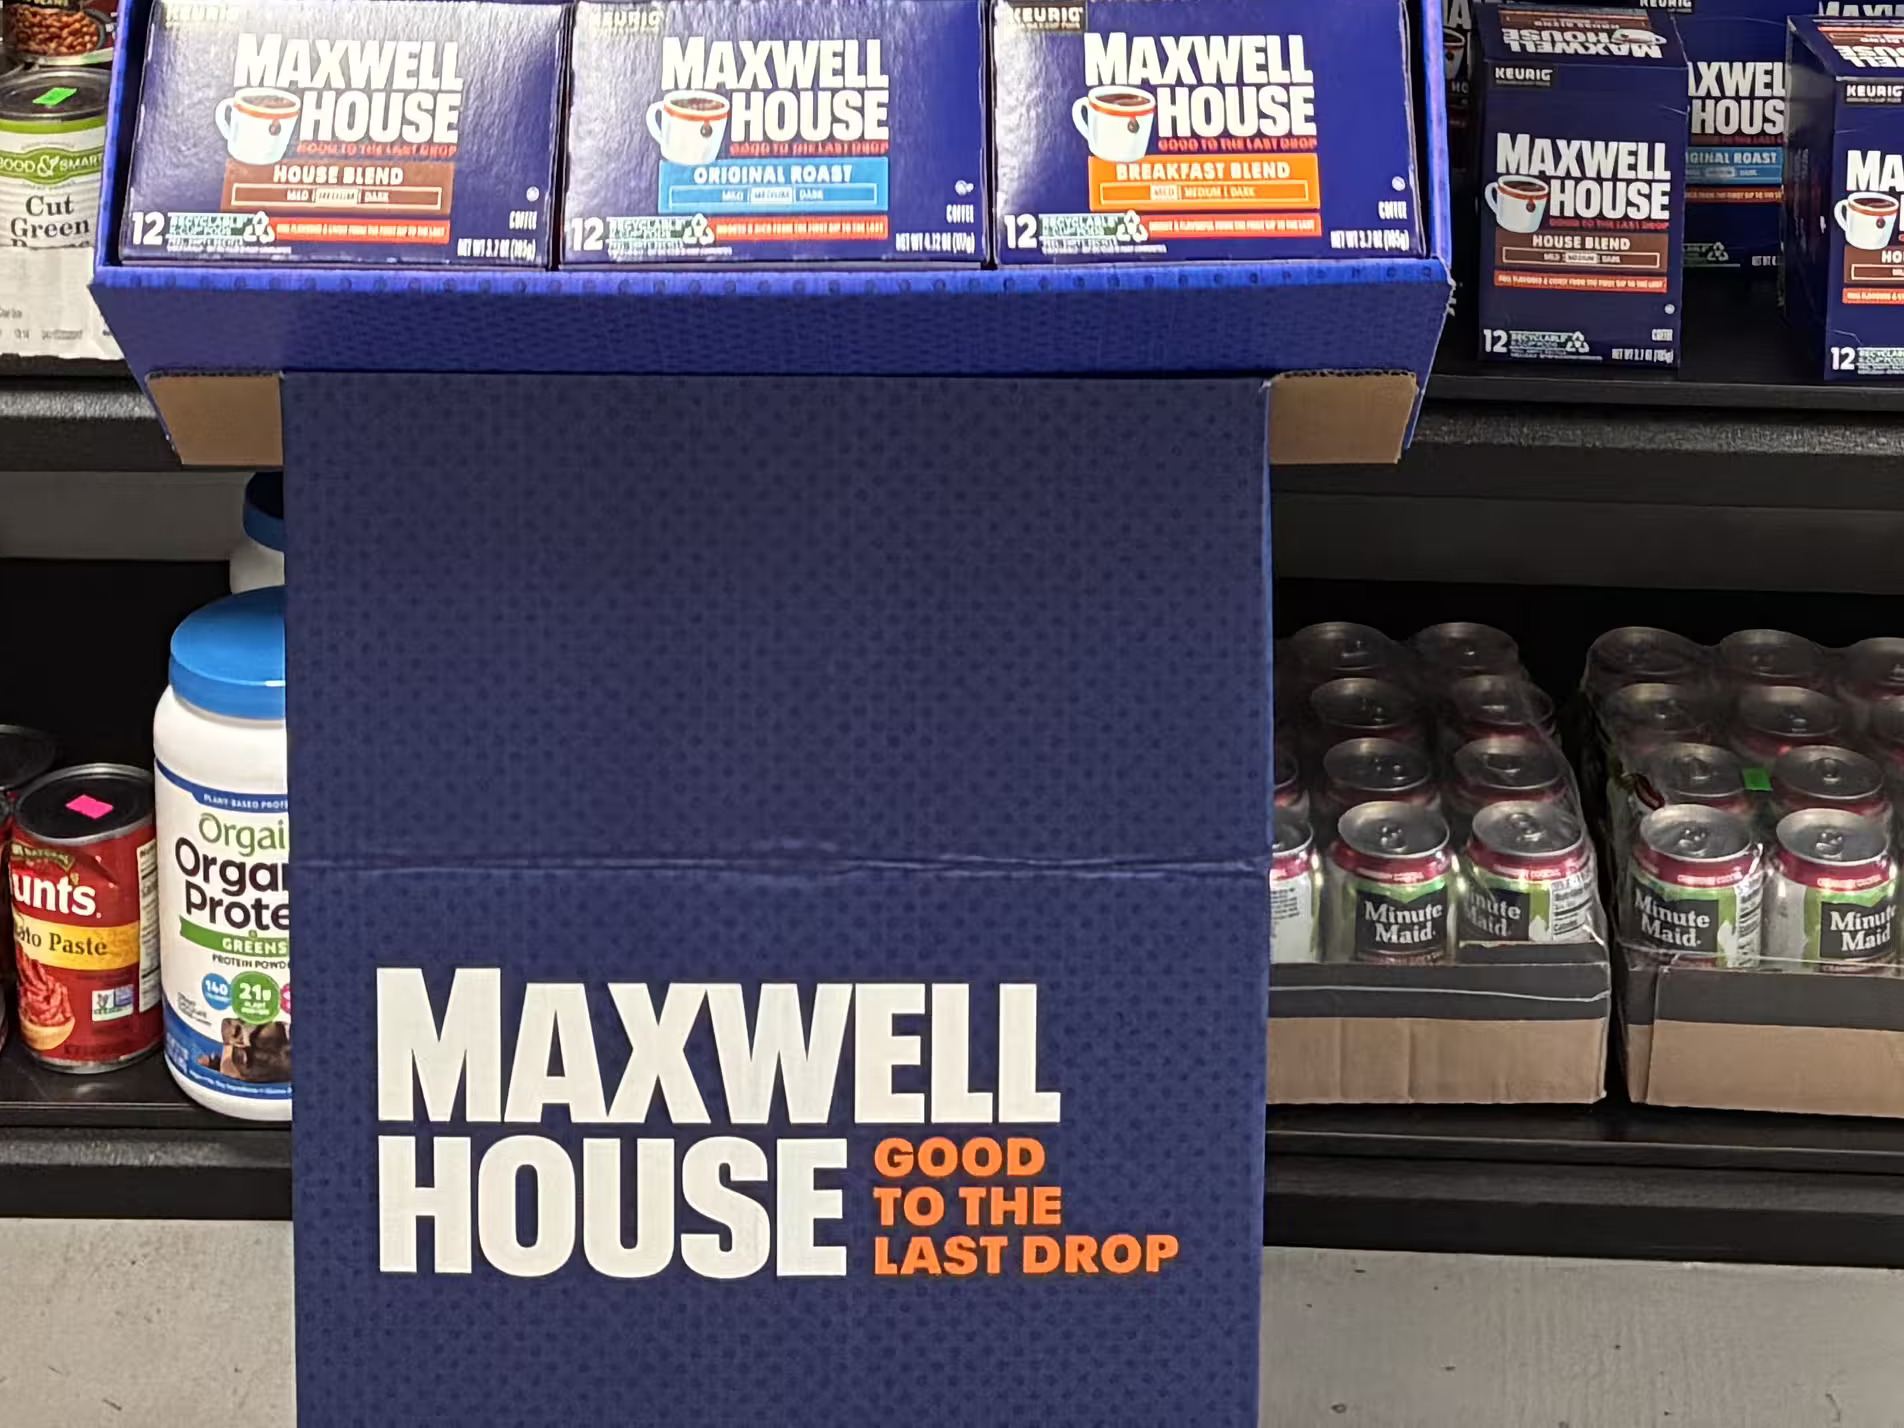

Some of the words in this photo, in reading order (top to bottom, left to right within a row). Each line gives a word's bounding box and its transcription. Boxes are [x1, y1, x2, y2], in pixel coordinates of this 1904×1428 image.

[233, 33, 464, 91] MAXWELL
[661, 36, 890, 90] MAXWELL
[1084, 32, 1314, 86] MAXWELL
[298, 90, 460, 144] HOUSE
[729, 88, 889, 142] HOUSE
[1156, 85, 1317, 137] HOUSE
[272, 165, 339, 184] HOUSE
[344, 165, 403, 185] BLEND
[693, 165, 781, 185] ORIGINAL
[789, 165, 853, 183] ROAST
[1116, 162, 1226, 180] BREAKFAST
[1230, 162, 1291, 179] BLEND
[1496, 133, 1671, 181] MAXWELL
[25, 195, 74, 216] Cut
[1549, 178, 1671, 220] HOUSE
[11, 218, 90, 239] Green
[1004, 214, 1038, 249] 12
[1364, 903, 1443, 924] Minute
[48, 936, 108, 957] Paste
[222, 937, 287, 955] GREENS
[376, 967, 1060, 1124] MAXWELL
[874, 1137, 1046, 1178] GOOD
[378, 1135, 848, 1279] HOUSE
[874, 1186, 946, 1227] TO
[960, 1187, 1062, 1226] THE
[874, 1235, 1010, 1276] LAST
[1023, 1235, 1180, 1274] DROP
